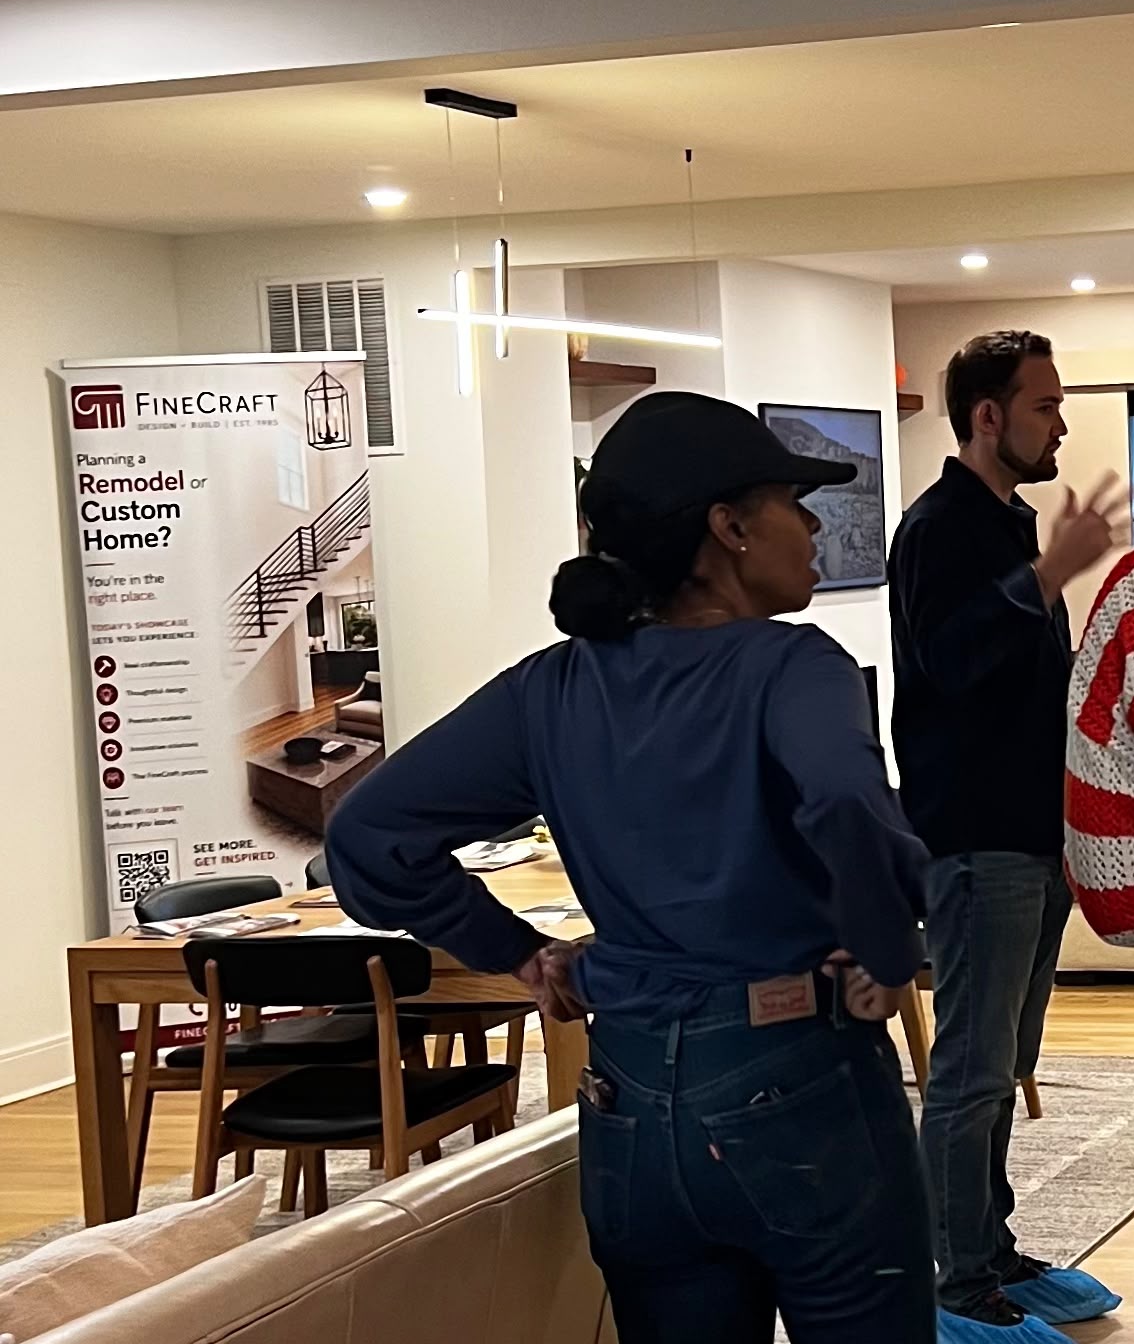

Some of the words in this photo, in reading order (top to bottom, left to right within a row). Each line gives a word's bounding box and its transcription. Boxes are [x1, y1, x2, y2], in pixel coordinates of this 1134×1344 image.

[137, 422, 177, 431] DESIGN
[191, 420, 221, 429] BUILD
[77, 452, 135, 467] Planning
[138, 454, 146, 465] a
[79, 469, 184, 494] Remodel
[190, 477, 208, 489] or
[81, 500, 181, 523] Custom
[83, 525, 171, 551] Home?
[86, 575, 126, 587] You're
[130, 574, 141, 585] in
[143, 573, 165, 585] the
[88, 592, 118, 606] right
[134, 618, 189, 630] SHOWCASE
[117, 635, 137, 643] YOU
[193, 842, 216, 854] SEE
[194, 855, 217, 868] GET
